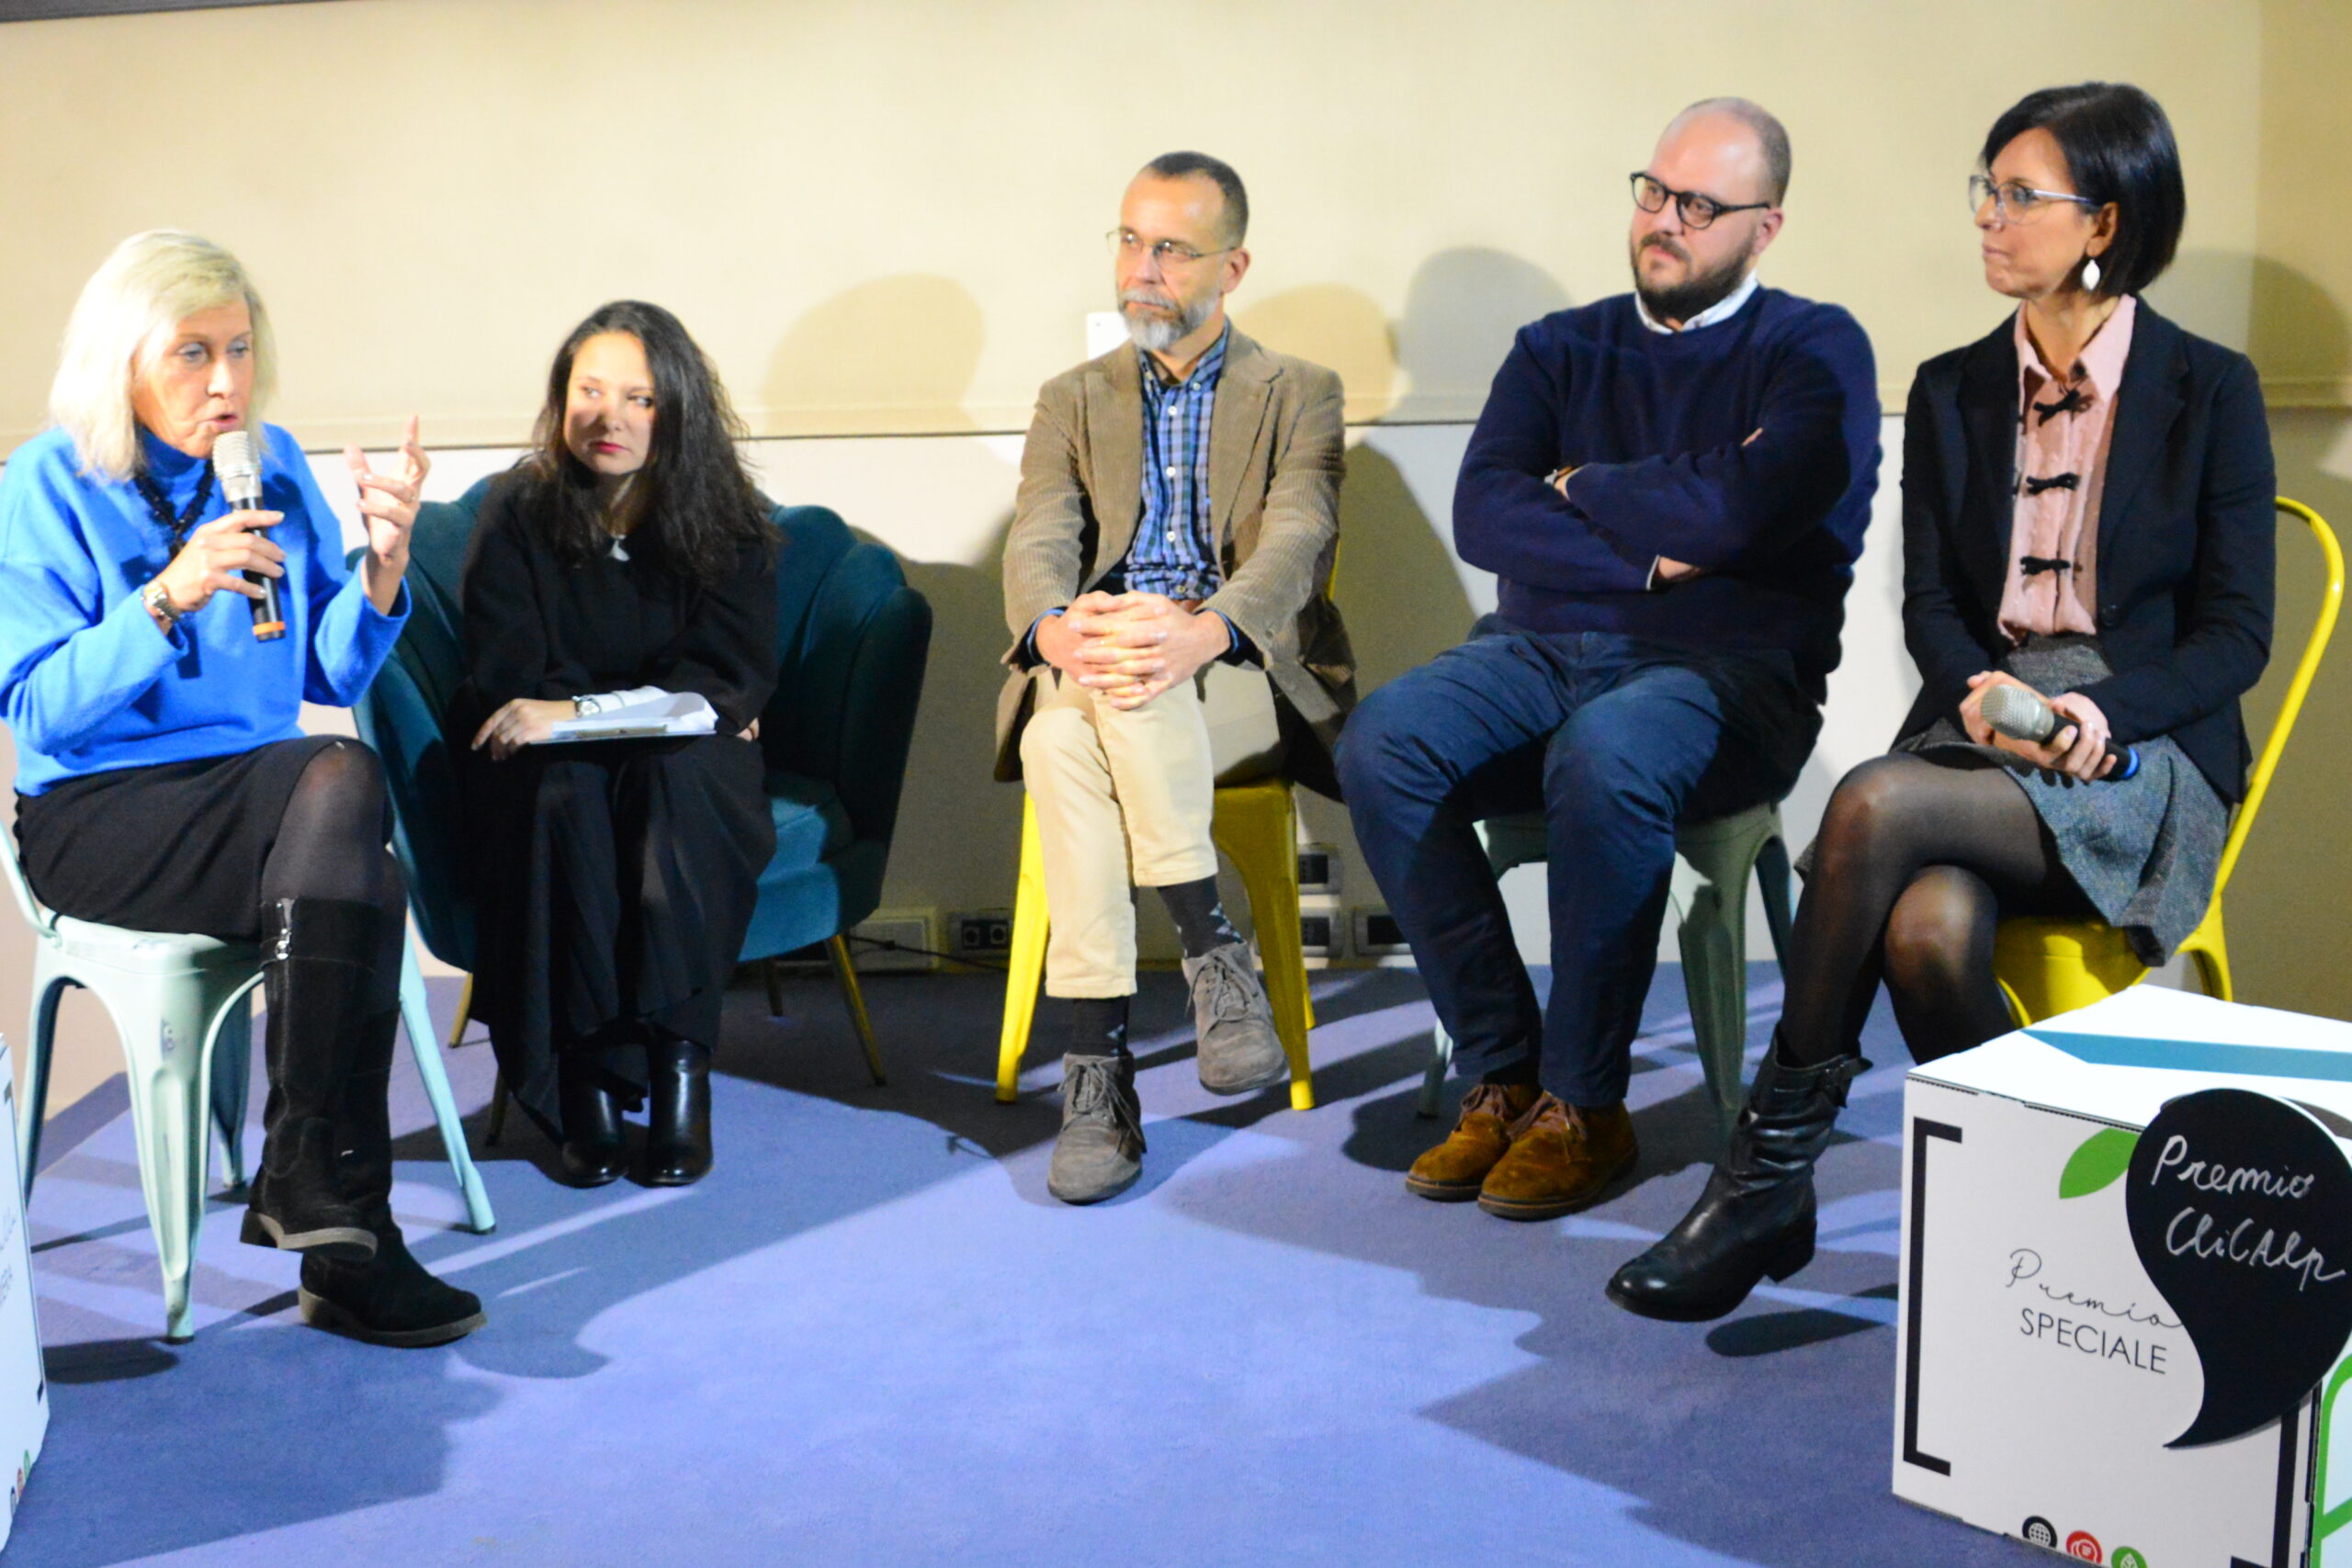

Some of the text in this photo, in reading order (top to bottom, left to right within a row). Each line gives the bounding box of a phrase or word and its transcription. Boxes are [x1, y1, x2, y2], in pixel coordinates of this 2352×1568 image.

[2151, 1134, 2314, 1198] Premio
[2006, 1248, 2182, 1328] Premio
[2020, 1307, 2167, 1375] SPECIALE
